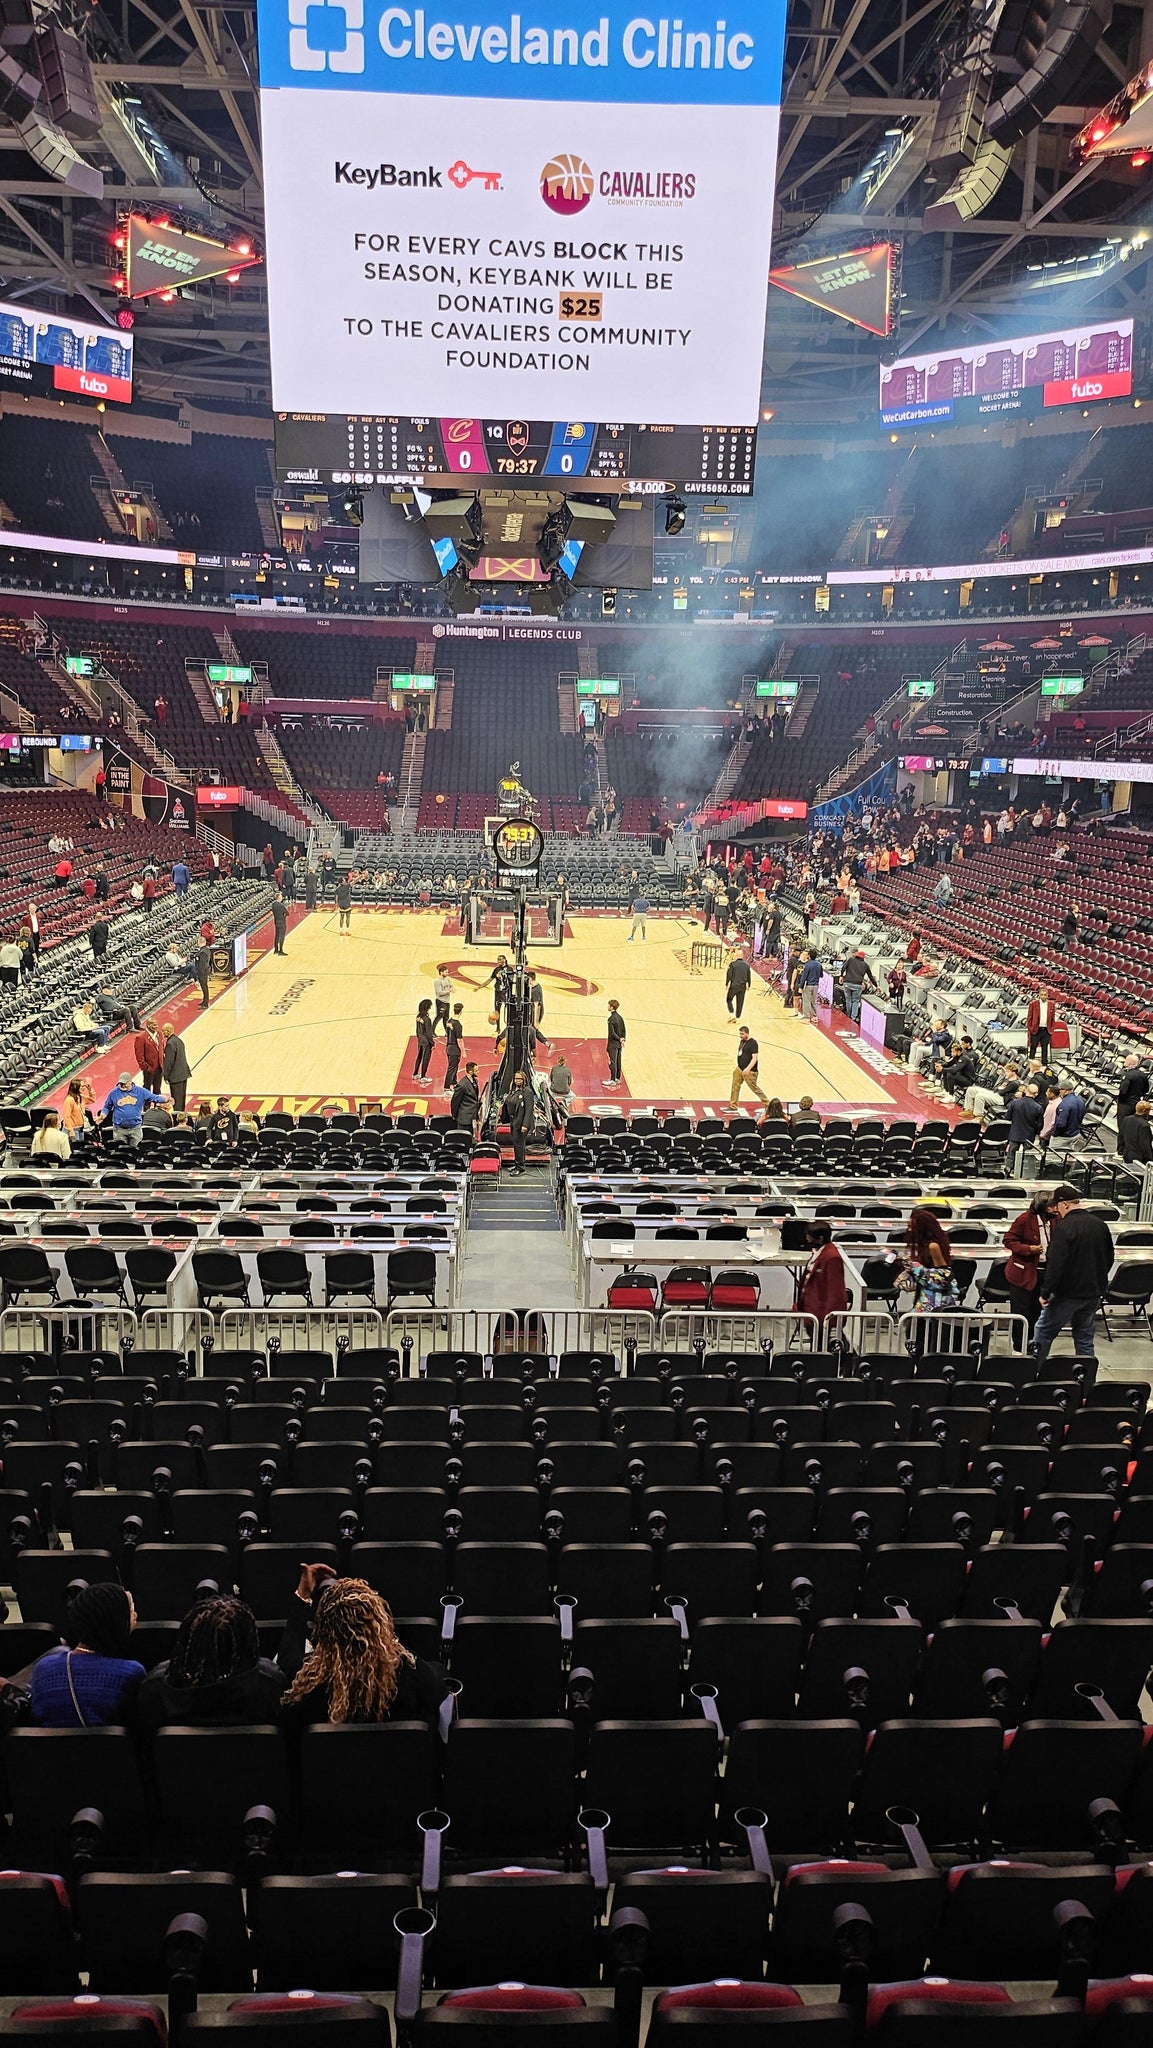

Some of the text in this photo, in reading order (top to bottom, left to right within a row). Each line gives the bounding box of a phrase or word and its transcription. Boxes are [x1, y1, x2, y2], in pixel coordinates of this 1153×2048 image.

[379, 9, 754, 71] Cleveland Clinic
[335, 161, 442, 190] KeyBank
[600, 171, 696, 199] CAVALIERS
[143, 240, 200, 266] LET EM
[354, 233, 684, 262] FOR EVERY CAVS BLOCK THIS
[136, 248, 194, 275] KNOW.
[364, 263, 673, 290] SEASON, KEYBANK WILL BE
[813, 260, 866, 284] LET EM
[820, 269, 876, 294] KNOW.
[438, 294, 601, 318] DONATING $25
[344, 318, 692, 347] TO THE CAVALIERS COMMUNITY
[446, 350, 590, 371] FOUNDATION
[80, 376, 107, 394] fubo
[1072, 382, 1102, 398] fubo
[982, 392, 1009, 402] WELCOME
[292, 414, 326, 422] CAVALIERS
[882, 406, 950, 424] WeCutCarbon.com
[487, 426, 503, 438] 1Q
[612, 430, 618, 438] 0
[460, 450, 471, 468] 0
[497, 459, 537, 474] 79:37
[561, 454, 572, 473] 0
[287, 468, 318, 480] oswald
[377, 475, 424, 485] RAFFLE
[629, 482, 665, 494] $4,000
[685, 484, 750, 493] CAVS5050.COM
[964, 558, 1084, 575] CAVS TICKETS ON SALE NOW
[446, 624, 499, 640] Huntington
[509, 629, 582, 640] LEGENDS CLUB
[12, 738, 17, 746] 0
[22, 737, 57, 746] REBOUNDS
[65, 739, 70, 747] 0
[925, 759, 931, 768] 0
[948, 760, 969, 770] 79:37
[984, 761, 990, 770] 0
[858, 796, 870, 804] Full
[504, 826, 535, 840] 79:37
